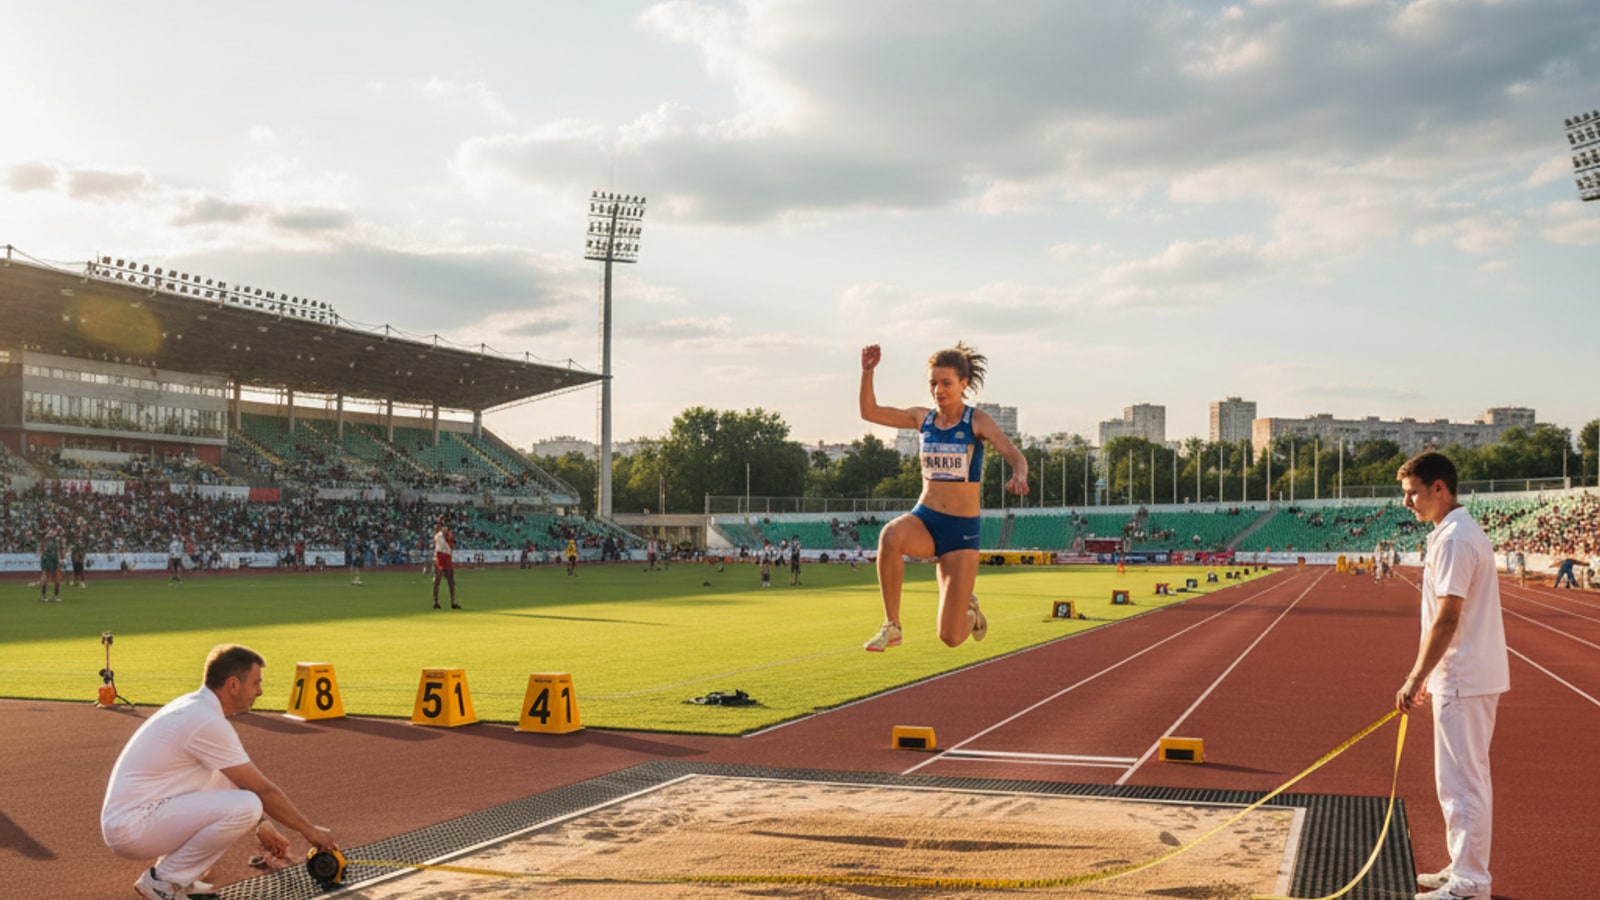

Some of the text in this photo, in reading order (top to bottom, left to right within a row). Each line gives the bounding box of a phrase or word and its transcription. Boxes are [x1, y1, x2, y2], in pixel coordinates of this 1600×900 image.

[294, 678, 304, 710] 1
[316, 677, 334, 711] 8
[422, 682, 442, 718] 5
[454, 682, 465, 717] 1
[528, 687, 551, 724] 4
[561, 687, 571, 723] 1
